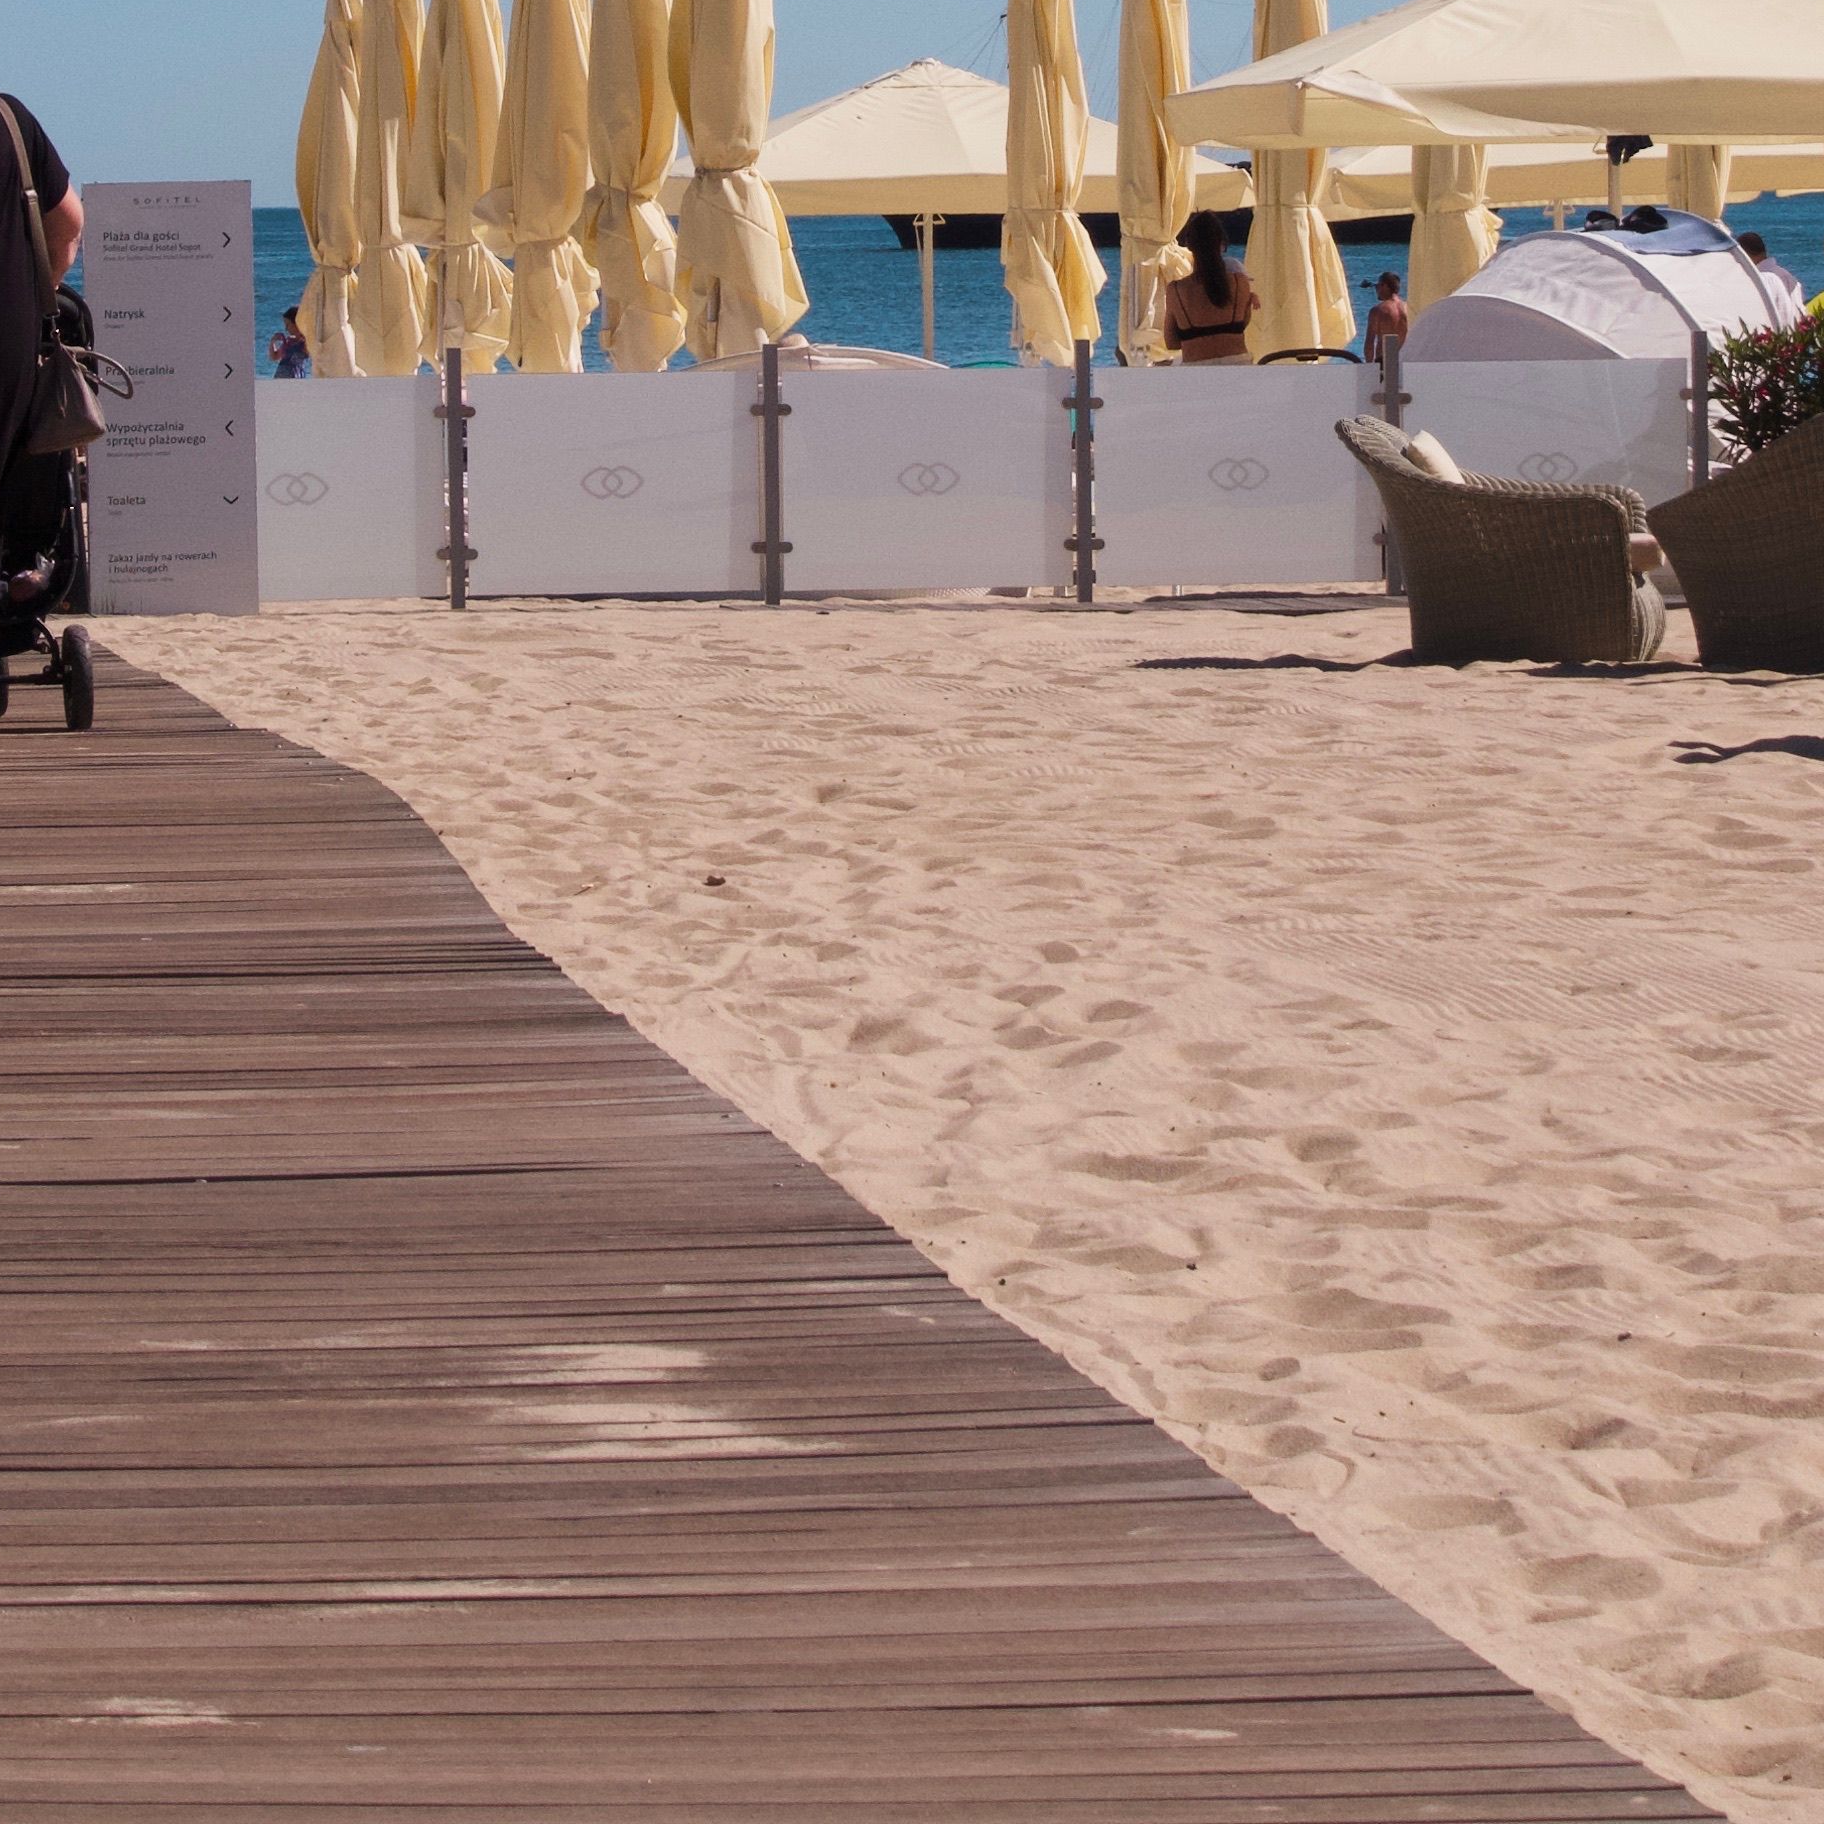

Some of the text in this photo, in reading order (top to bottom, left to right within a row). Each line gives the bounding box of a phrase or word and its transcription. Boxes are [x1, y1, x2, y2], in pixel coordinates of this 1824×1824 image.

[133, 196, 201, 205] SOFITEL
[103, 230, 180, 243] Plaża dla gości
[155, 243, 177, 251] Hotel
[104, 308, 145, 320] Natrysk
[105, 365, 175, 376] Przbieralnia
[105, 421, 185, 434] Wypożyczalnia
[106, 434, 207, 447] sprzętu plażowego
[107, 496, 146, 506] Toaleta
[108, 553, 133, 563] Zakaz
[135, 552, 159, 564] jazdy
[175, 551, 218, 561] rowerach
